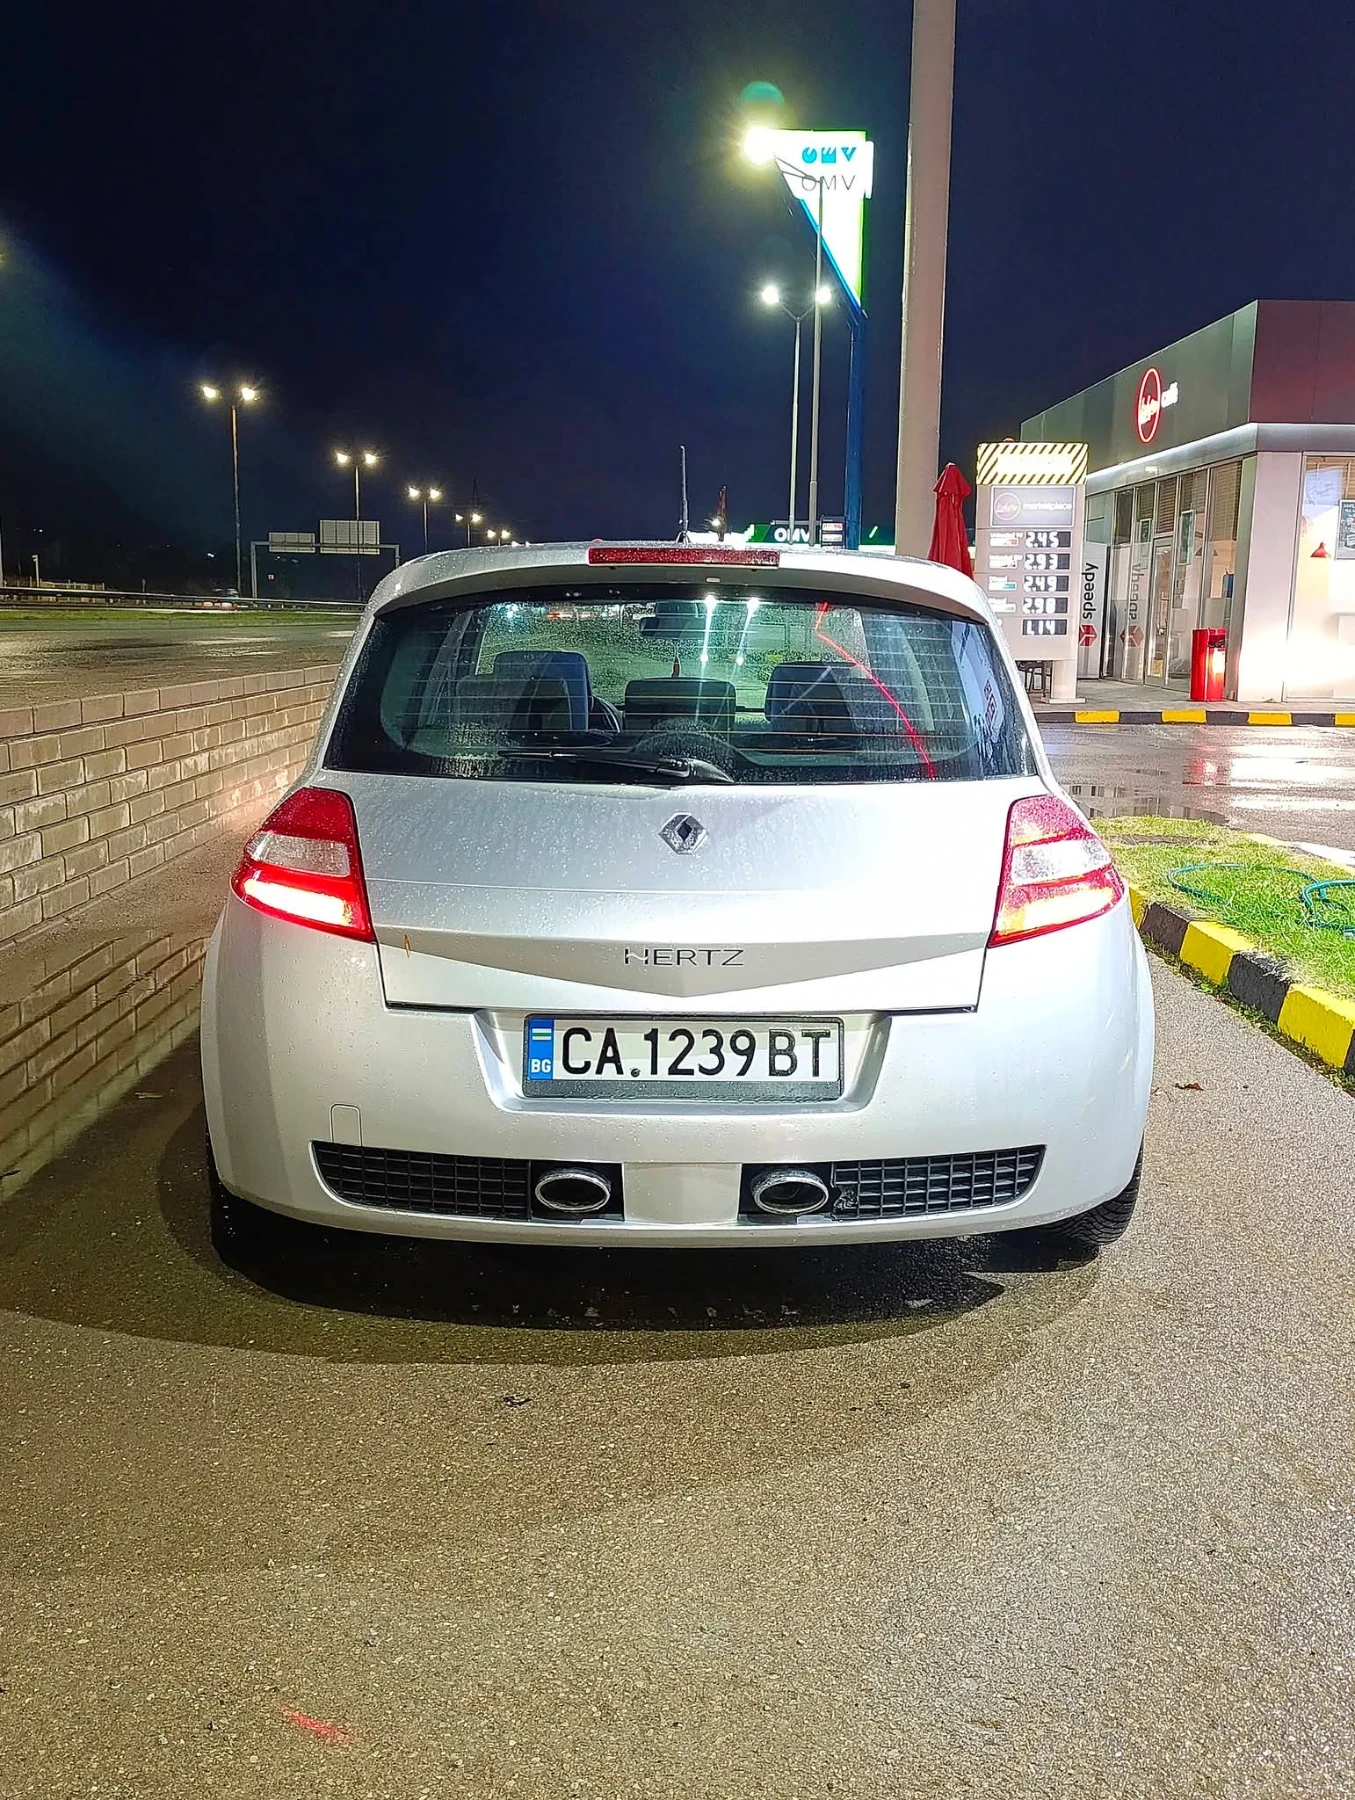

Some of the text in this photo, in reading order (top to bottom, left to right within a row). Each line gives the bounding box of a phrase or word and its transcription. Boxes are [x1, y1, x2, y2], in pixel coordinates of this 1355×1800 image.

[801, 174, 856, 192] OMV
[774, 527, 812, 543] OMV
[1025, 531, 1060, 548] 2.45
[1024, 553, 1059, 570] 2.93
[1023, 575, 1058, 592] 2.49
[1081, 562, 1099, 619] speedy
[624, 948, 745, 967] HERTZ
[531, 1058, 552, 1075] BG
